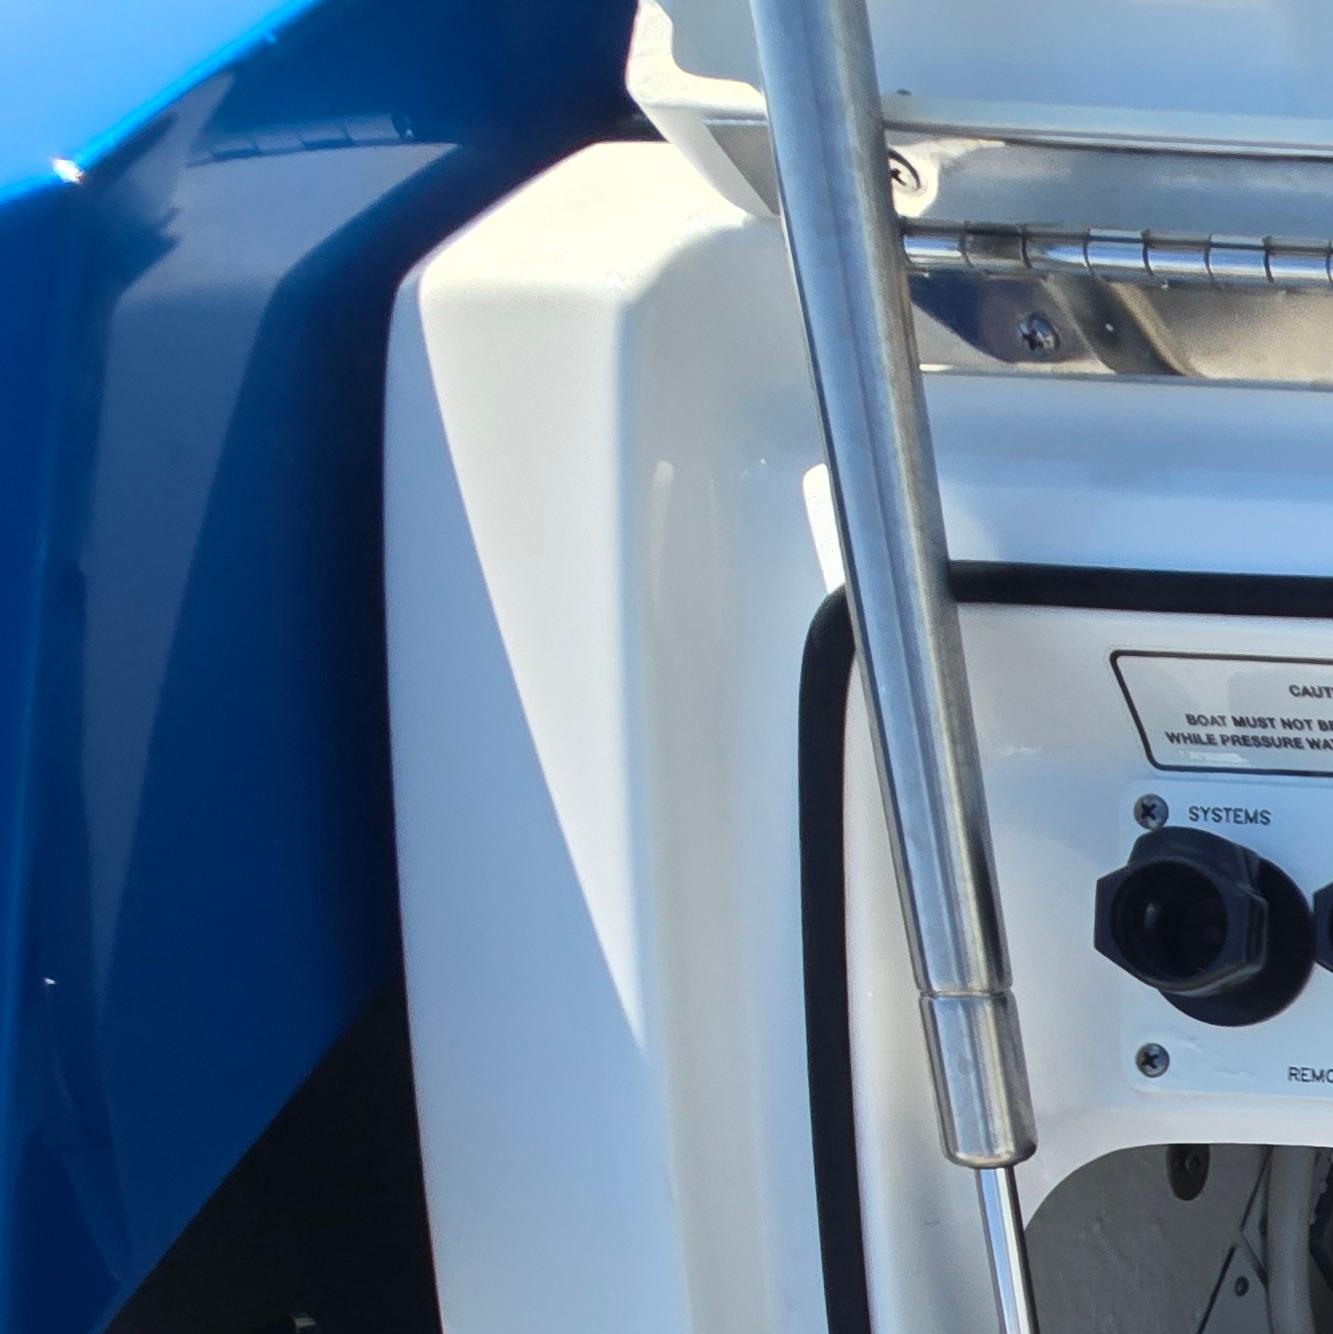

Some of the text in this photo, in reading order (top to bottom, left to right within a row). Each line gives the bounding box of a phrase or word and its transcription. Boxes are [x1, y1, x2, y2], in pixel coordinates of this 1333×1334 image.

[1185, 713, 1227, 727] BOAT
[1231, 715, 1276, 730] MUST
[1280, 718, 1313, 731] NOT
[1165, 731, 1217, 746] WHILE
[1219, 733, 1304, 749] PRESSURE
[1189, 805, 1271, 825] SYSTEMS
